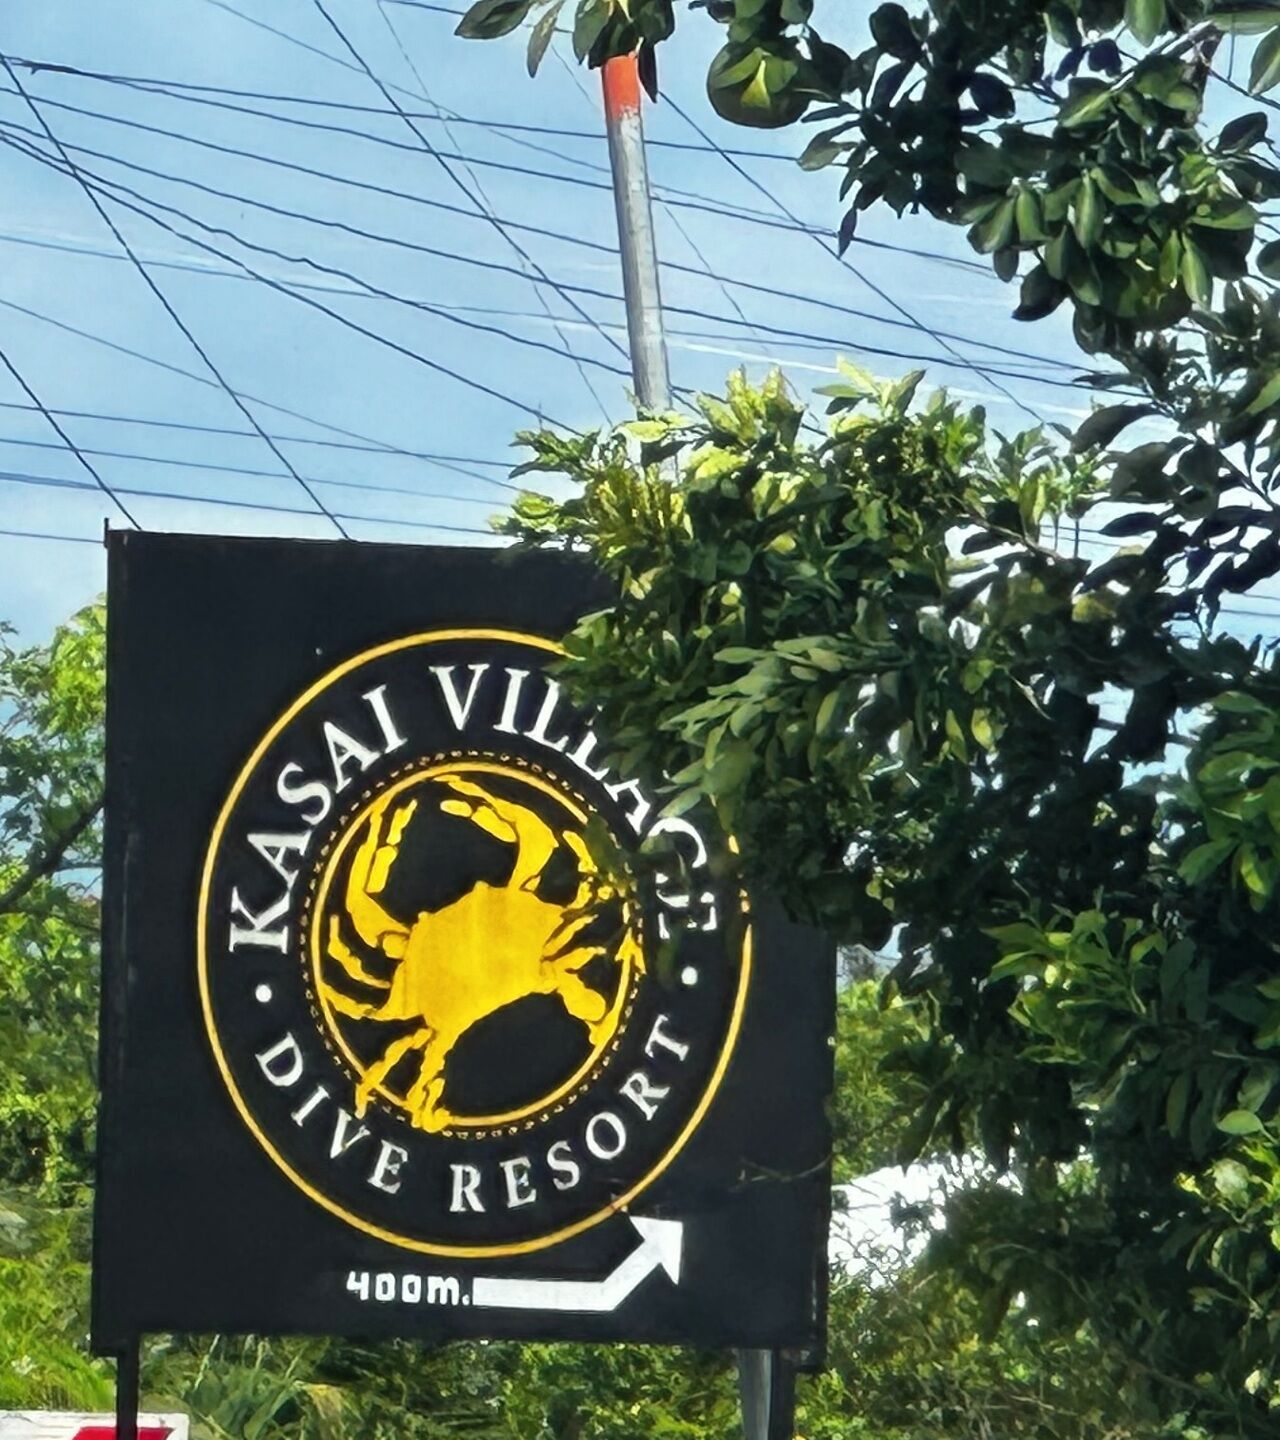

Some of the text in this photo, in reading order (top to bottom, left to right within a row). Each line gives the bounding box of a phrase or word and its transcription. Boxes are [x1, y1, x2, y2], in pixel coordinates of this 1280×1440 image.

[229, 684, 407, 953] KASAI
[256, 1014, 693, 1213] DIVE RESORT
